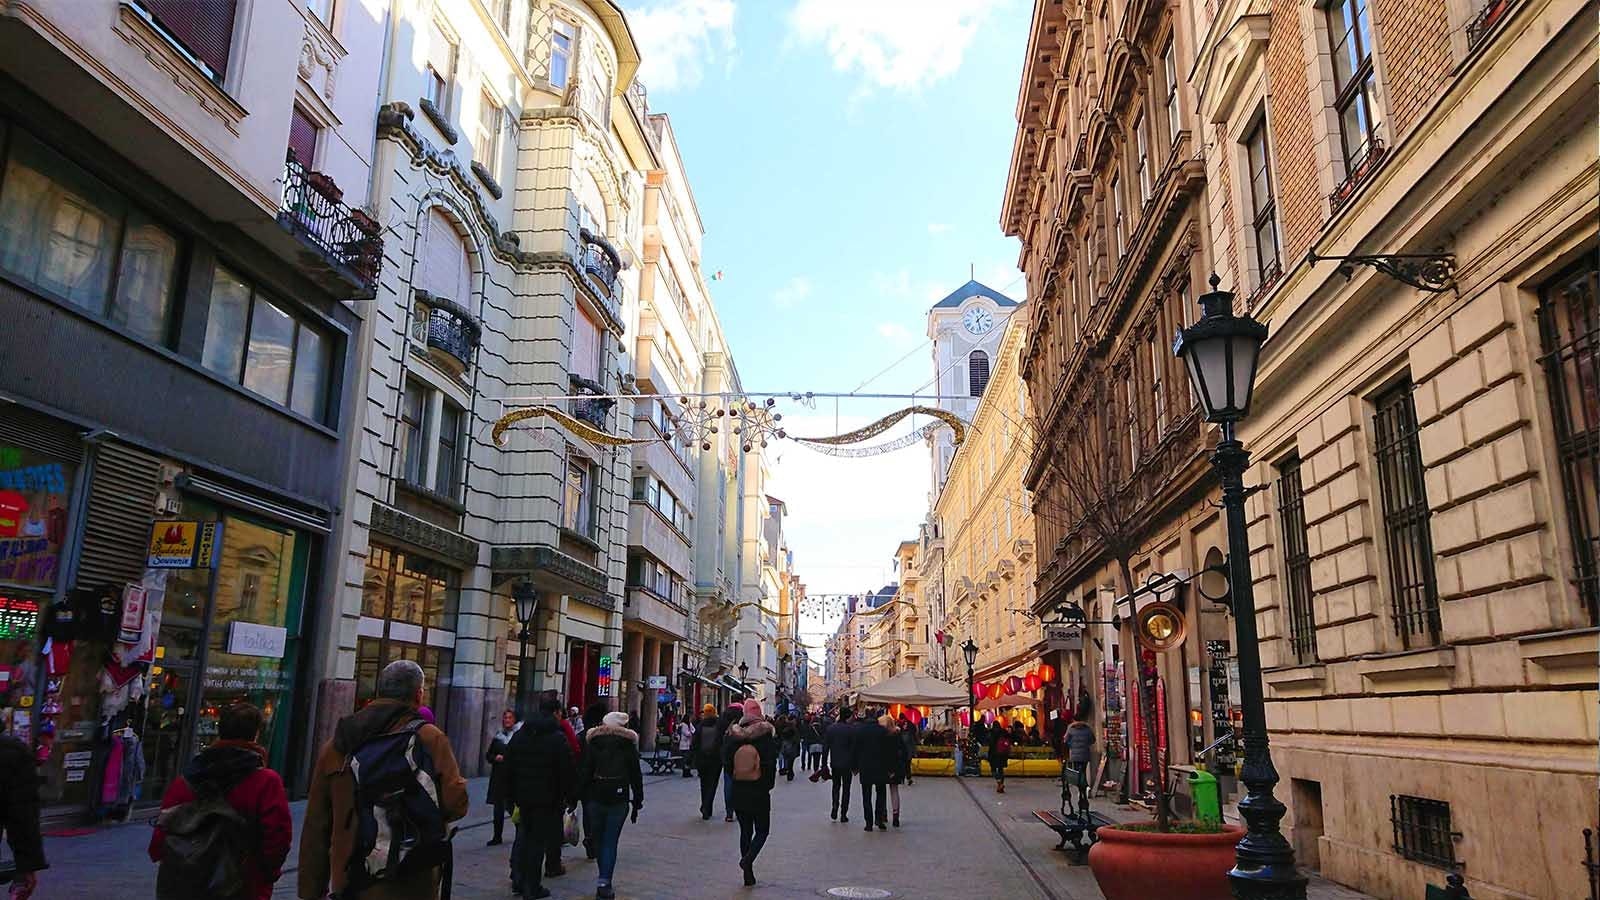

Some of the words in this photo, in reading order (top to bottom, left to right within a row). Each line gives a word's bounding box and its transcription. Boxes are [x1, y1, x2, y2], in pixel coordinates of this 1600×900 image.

[151, 542, 192, 556] Budapest
[152, 553, 189, 566] Souvenir
[1049, 631, 1081, 639] T-Stock
